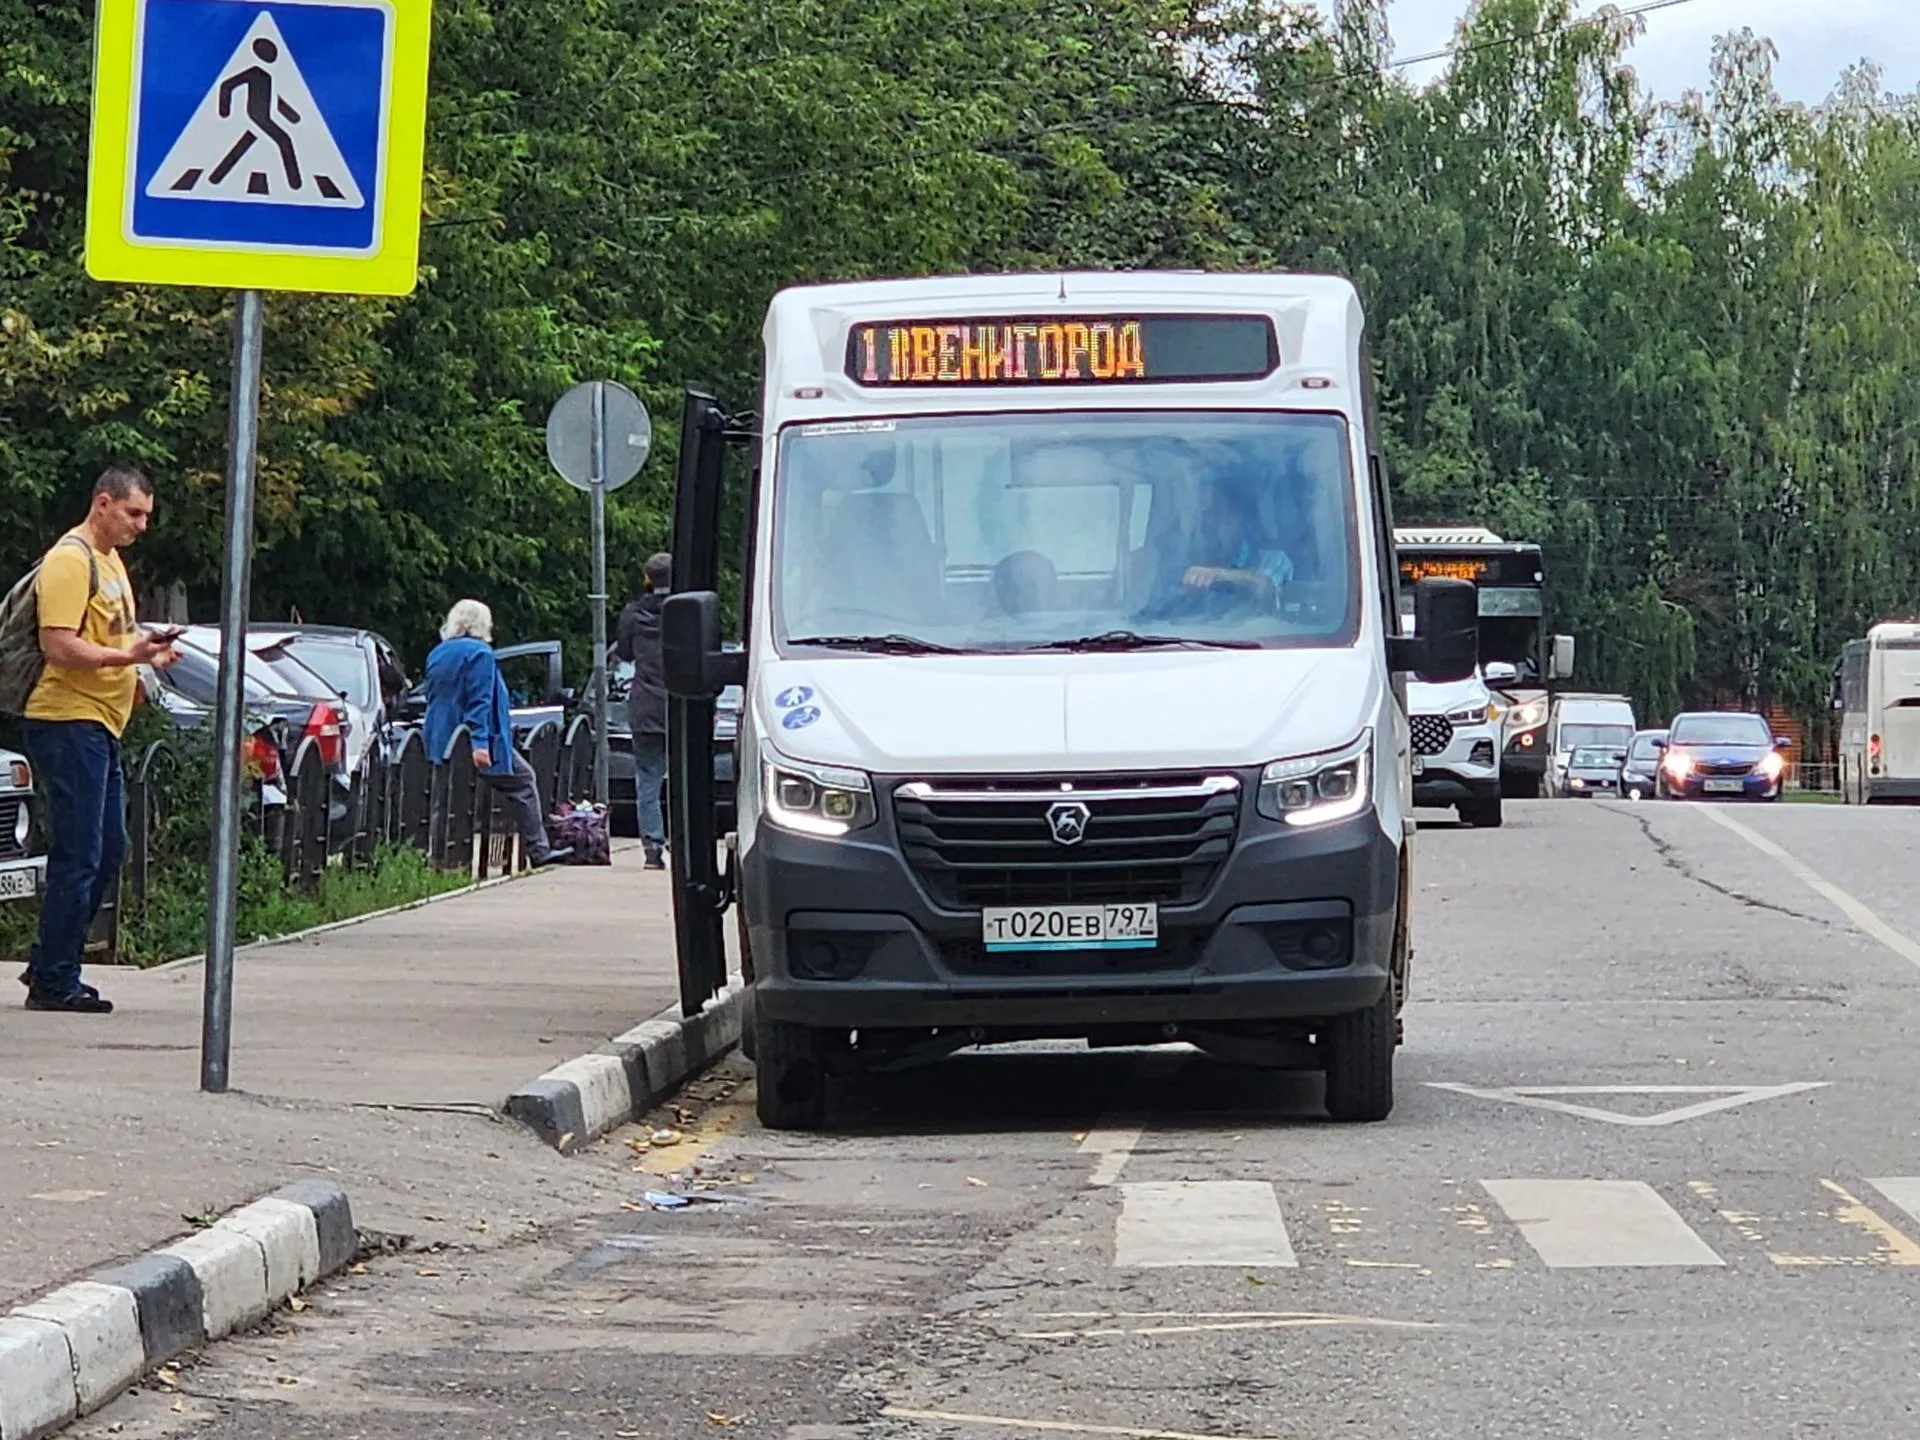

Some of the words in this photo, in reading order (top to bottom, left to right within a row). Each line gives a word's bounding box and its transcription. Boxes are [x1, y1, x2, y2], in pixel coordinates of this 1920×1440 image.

[863, 328, 878, 381] 1
[993, 911, 1101, 939] Т020ЕВ
[1106, 906, 1149, 929] 797
